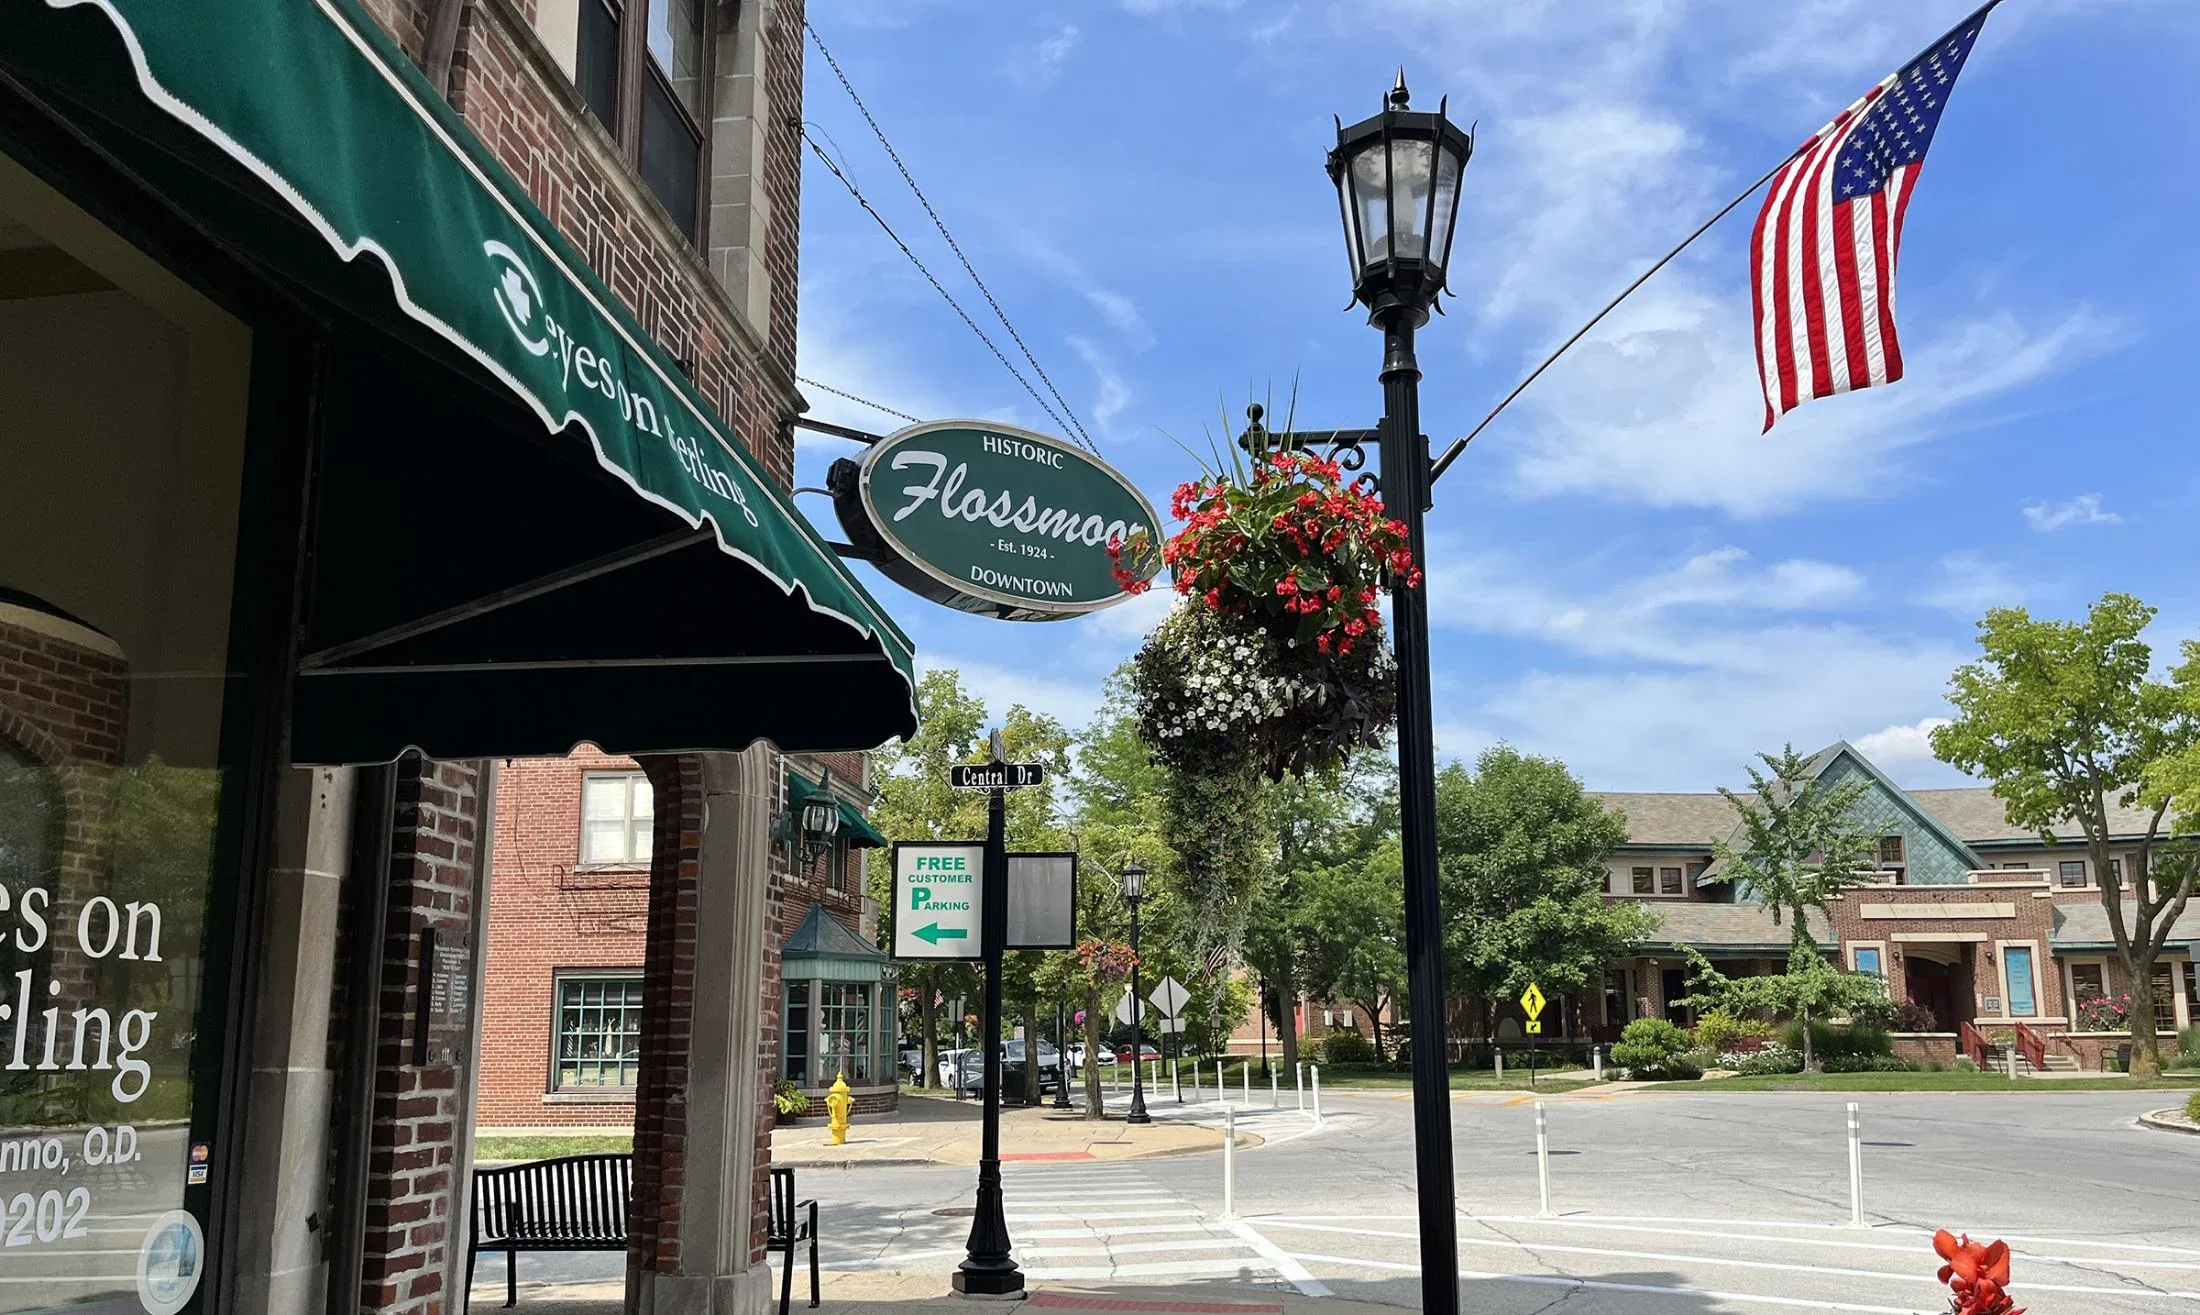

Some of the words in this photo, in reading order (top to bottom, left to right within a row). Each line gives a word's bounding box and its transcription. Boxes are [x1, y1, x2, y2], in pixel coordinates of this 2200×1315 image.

[617, 379, 663, 438] on
[983, 435, 1064, 470] HISTORIC
[998, 539, 1017, 554] Est.
[1020, 544, 1048, 560] 1924
[970, 565, 1074, 597] DOWNTOWN
[962, 766, 1008, 786] Central
[1017, 765, 1033, 785] Dr
[908, 874, 973, 883] CUSTOMER
[917, 857, 966, 870] FREE
[911, 887, 970, 911] PARKING
[77, 896, 163, 962] on
[83, 1125, 141, 1166] O.D.
[0, 1186, 91, 1248] 202
